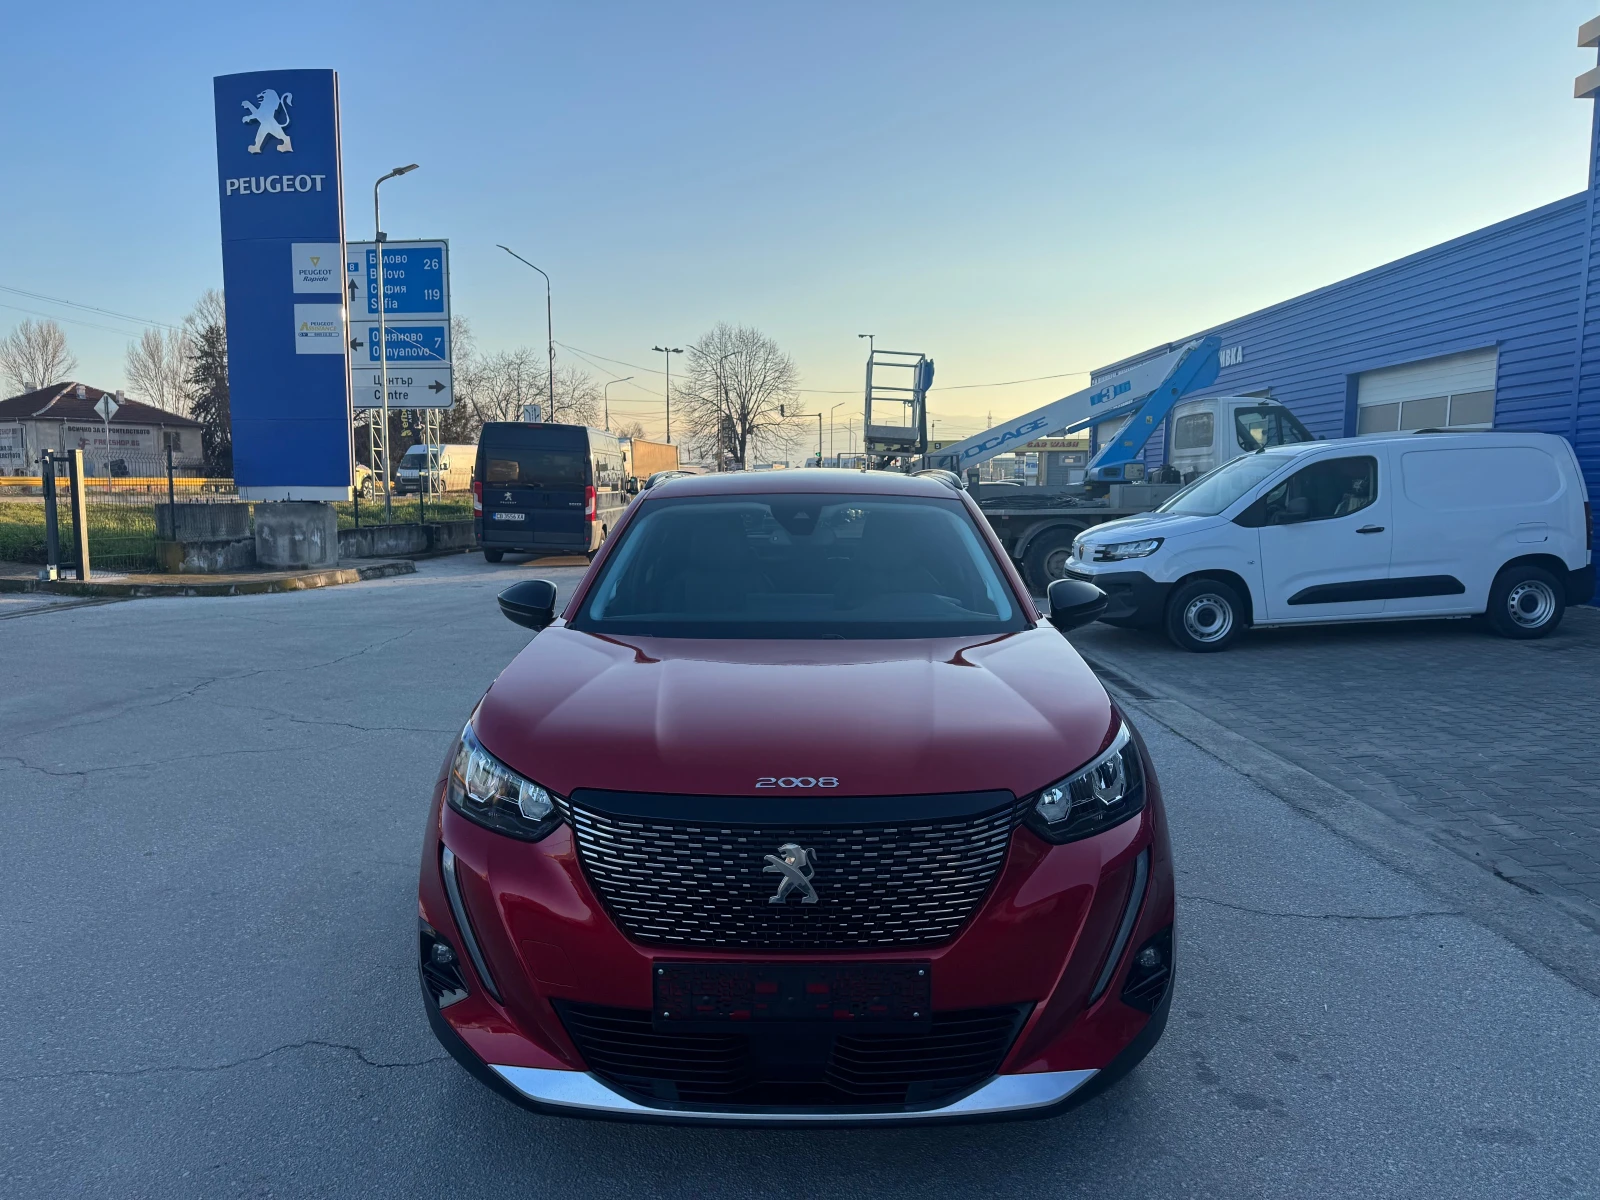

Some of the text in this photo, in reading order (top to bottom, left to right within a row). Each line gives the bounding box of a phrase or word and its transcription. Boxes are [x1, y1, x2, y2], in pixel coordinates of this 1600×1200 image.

[225, 174, 326, 196] PEUGEOT
[369, 253, 408, 264] Блово
[423, 259, 439, 270] 26
[370, 268, 405, 279] Blovo
[370, 283, 407, 295] Сфия
[424, 289, 440, 300] 119
[371, 298, 398, 309] Sfia
[372, 332, 423, 342] Оняново
[434, 337, 441, 348] 7
[372, 346, 430, 359] Onyanovo
[373, 375, 413, 387] Цнтър
[374, 389, 409, 400] Cntre
[101, 427, 151, 435] СРОИТЕЛСТВОТО
[755, 776, 840, 788] 2008
